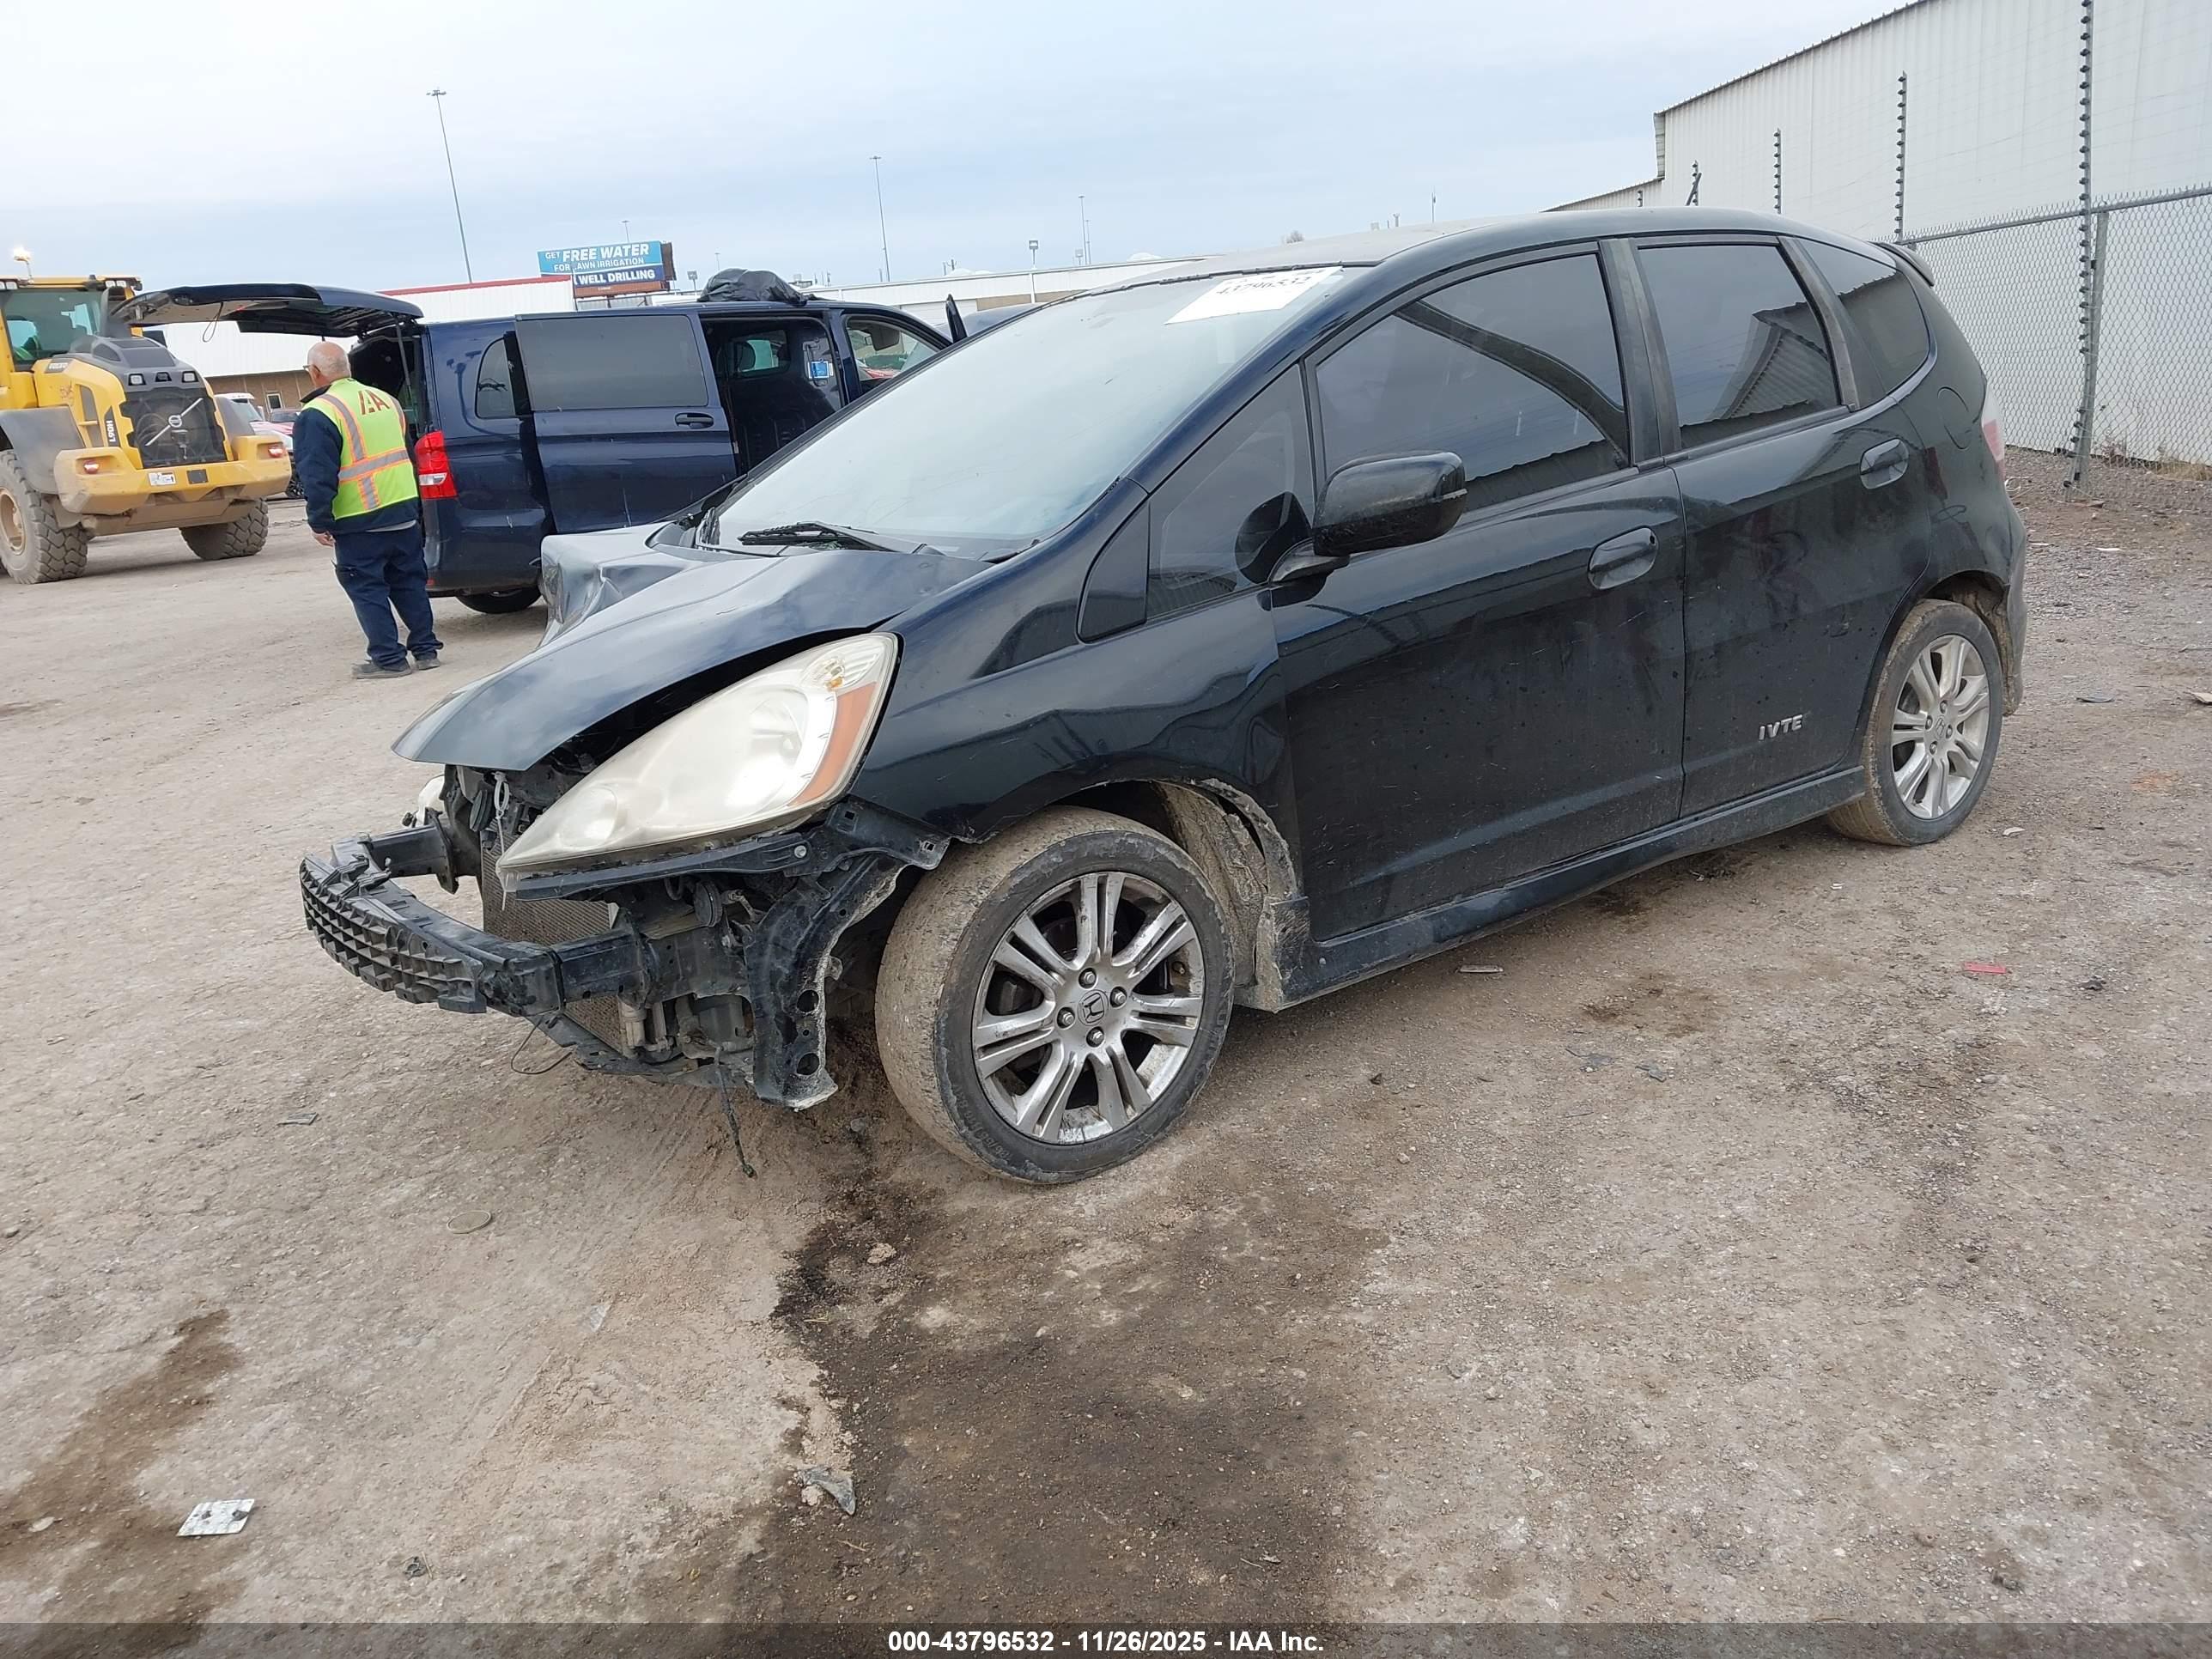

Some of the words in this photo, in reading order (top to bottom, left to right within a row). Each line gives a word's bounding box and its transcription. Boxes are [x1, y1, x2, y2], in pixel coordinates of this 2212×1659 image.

[562, 247, 598, 262] FREE
[600, 243, 649, 258] WATER
[554, 264, 571, 272] FOR
[597, 257, 645, 269] IRRIGATION
[578, 273, 607, 285] WELL
[607, 269, 656, 283] DRILLING
